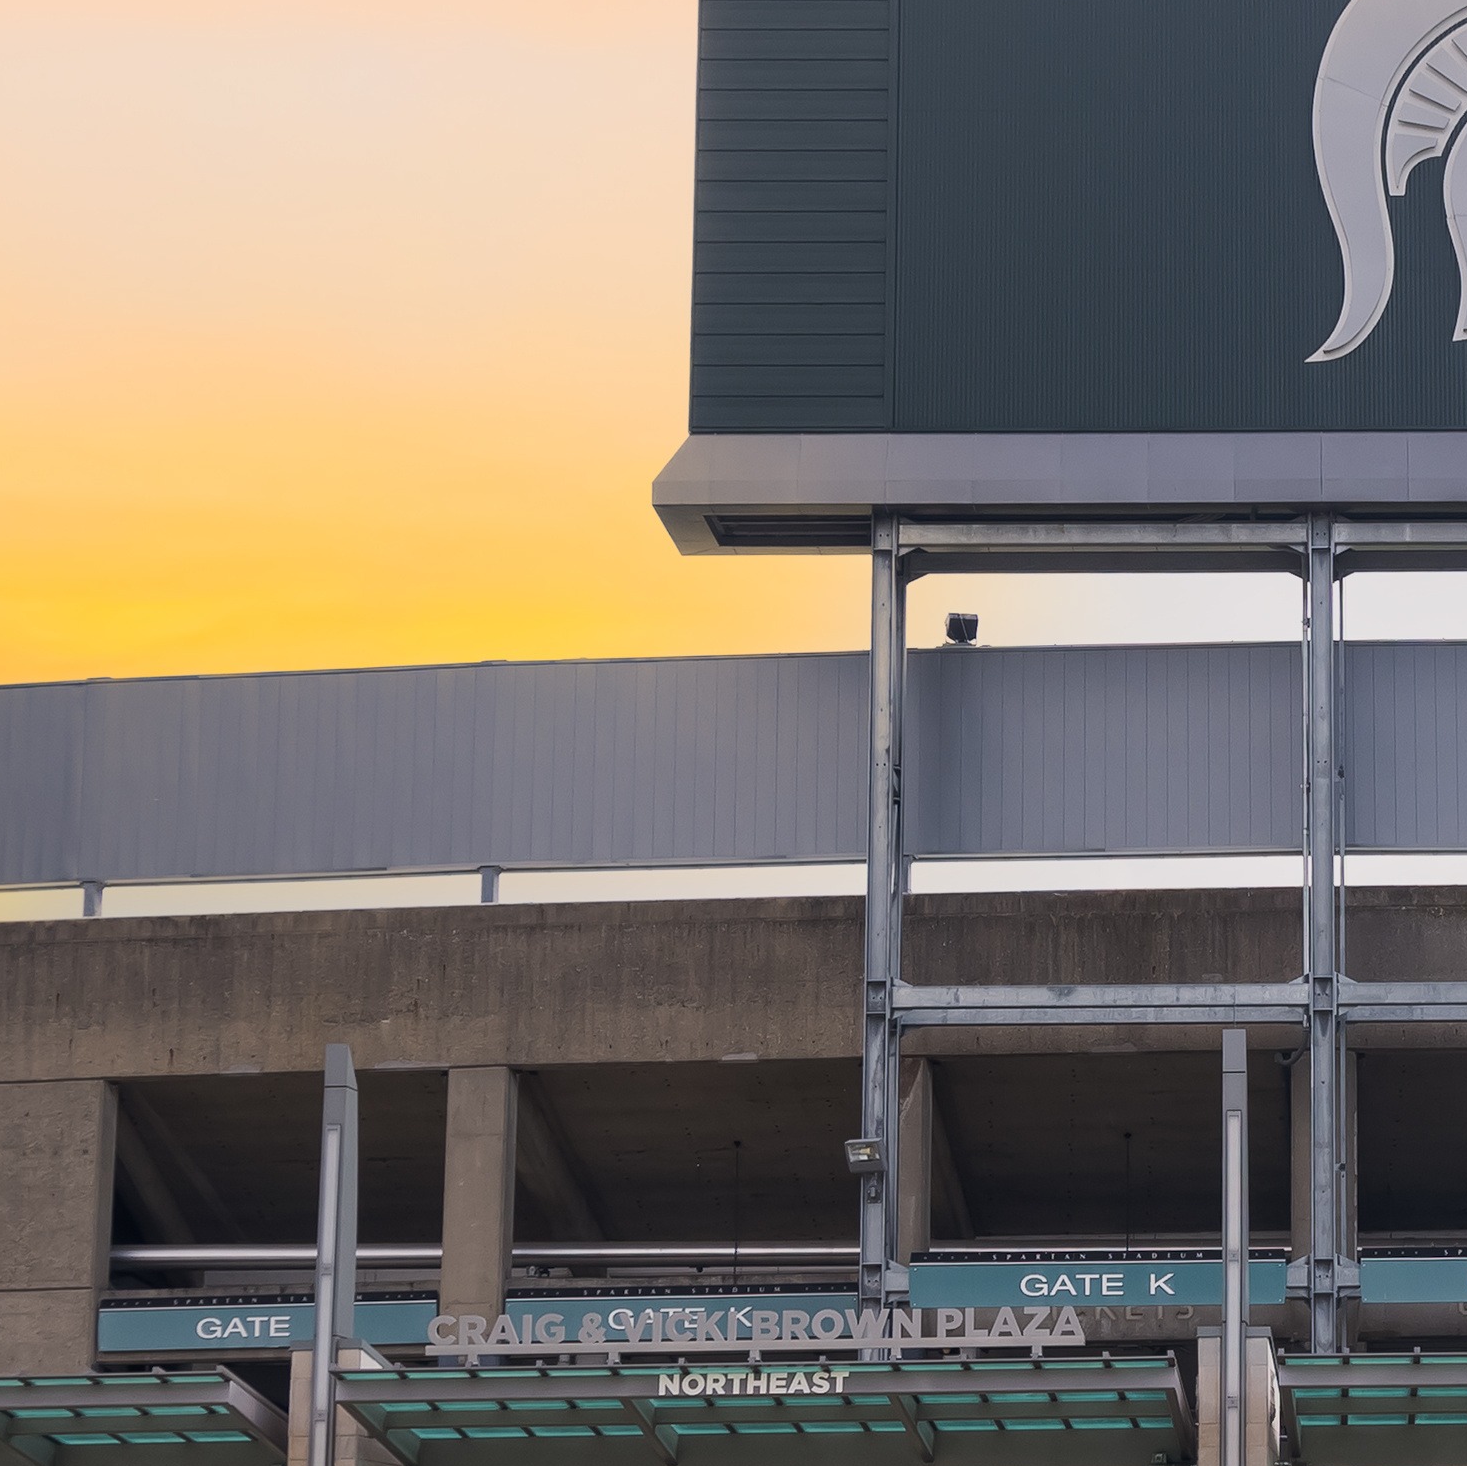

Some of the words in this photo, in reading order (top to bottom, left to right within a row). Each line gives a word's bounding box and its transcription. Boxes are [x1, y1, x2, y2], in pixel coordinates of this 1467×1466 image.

[991, 1252, 1087, 1261] SPARTAN
[1107, 1251, 1204, 1260] STADIUM
[583, 1288, 672, 1296] SPARTAN
[691, 1286, 782, 1295] STADIUM
[1019, 1272, 1125, 1297] GATE
[1148, 1272, 1176, 1296] K
[173, 1297, 258, 1306] SPARTAN
[276, 1295, 363, 1303] STAM
[195, 1315, 292, 1340] GATE
[427, 1313, 566, 1345] CRAIG
[578, 1312, 607, 1344] &
[617, 1310, 738, 1343] VICKI
[752, 1308, 922, 1341] BROWN
[937, 1306, 1084, 1338] PLAZA
[658, 1371, 850, 1396] NORTHEAST
